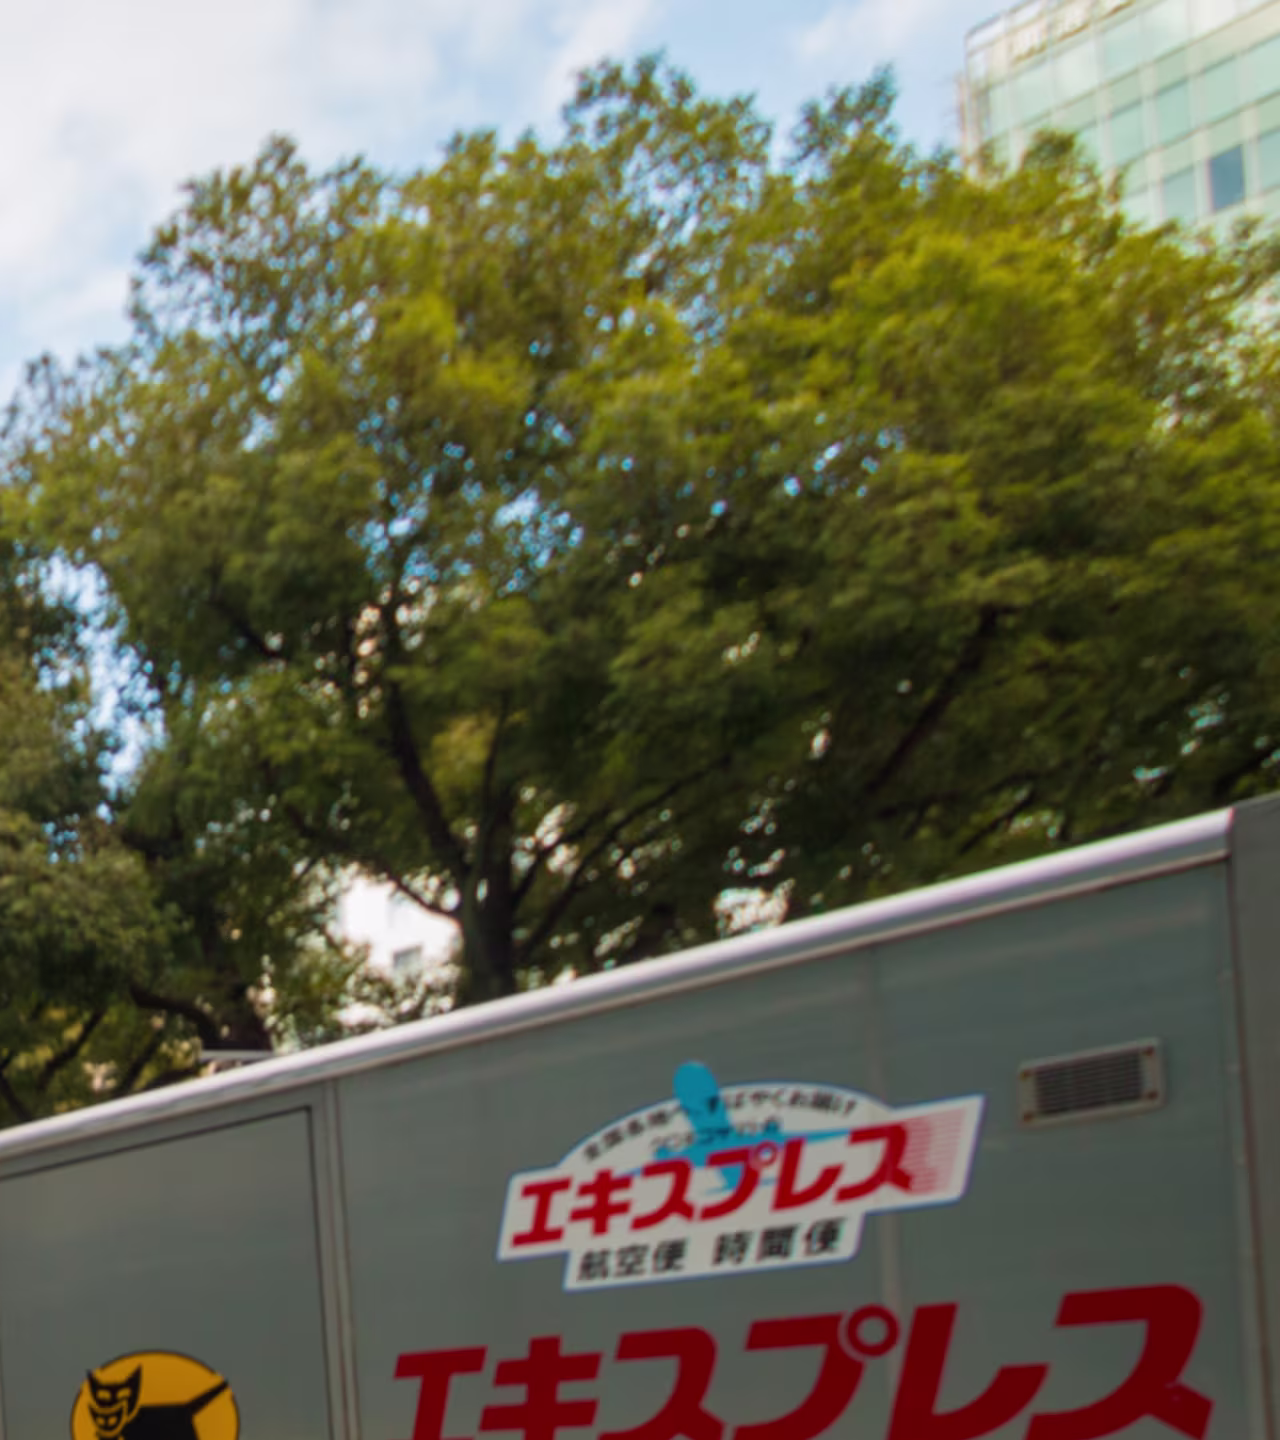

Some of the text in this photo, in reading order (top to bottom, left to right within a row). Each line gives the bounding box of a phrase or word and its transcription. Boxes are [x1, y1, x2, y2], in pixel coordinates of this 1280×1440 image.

[511, 1122, 912, 1248] エキスプレス
[577, 1217, 842, 1281] 航空便 時間便
